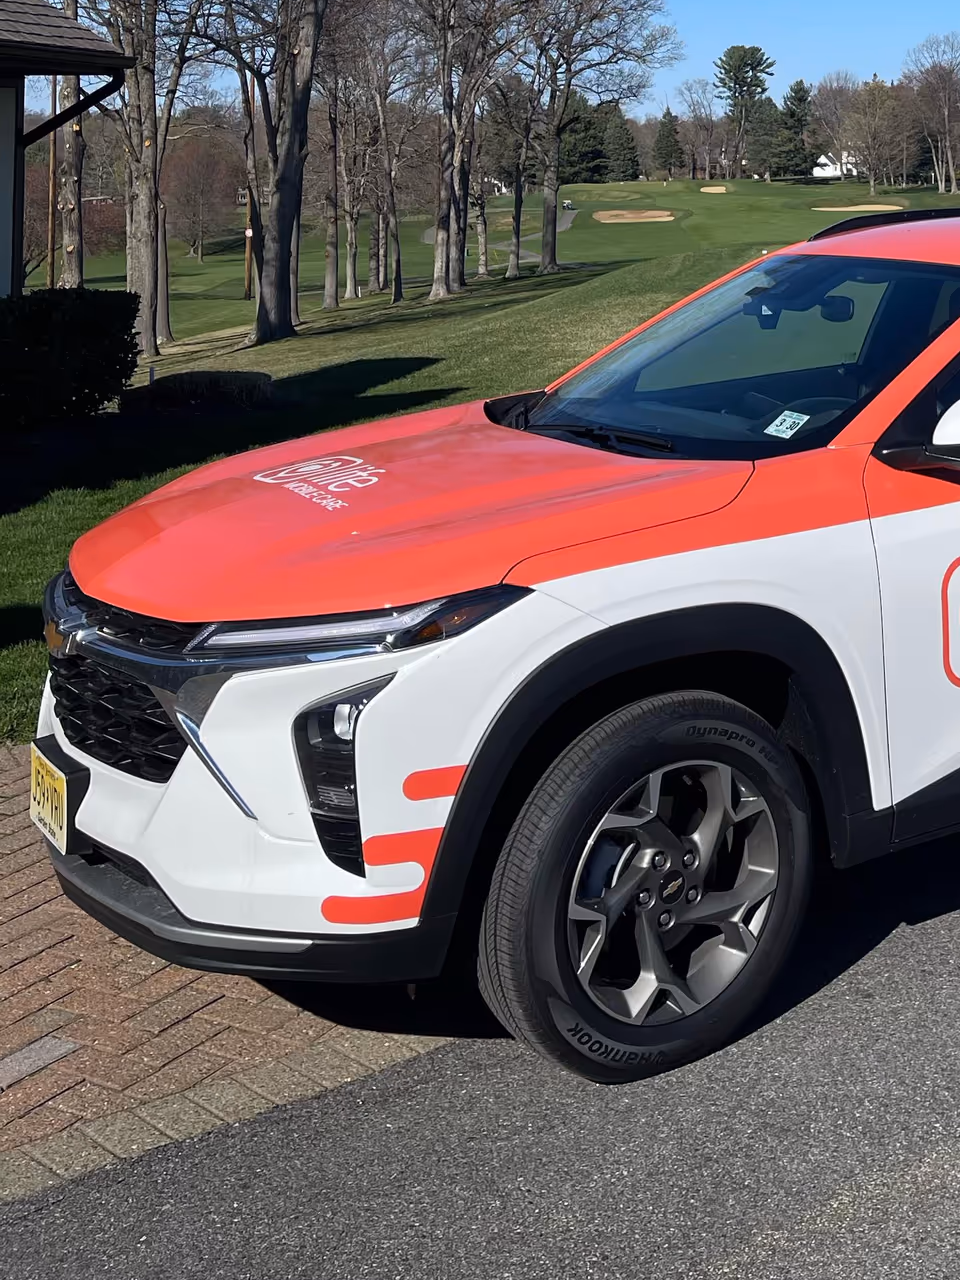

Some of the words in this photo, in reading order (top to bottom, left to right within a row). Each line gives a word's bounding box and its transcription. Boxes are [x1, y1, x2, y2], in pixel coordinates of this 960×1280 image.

[776, 419, 786, 427] 3
[305, 465, 386, 491] life
[280, 481, 325, 499] MOBILE
[686, 725, 756, 747] Dynapro
